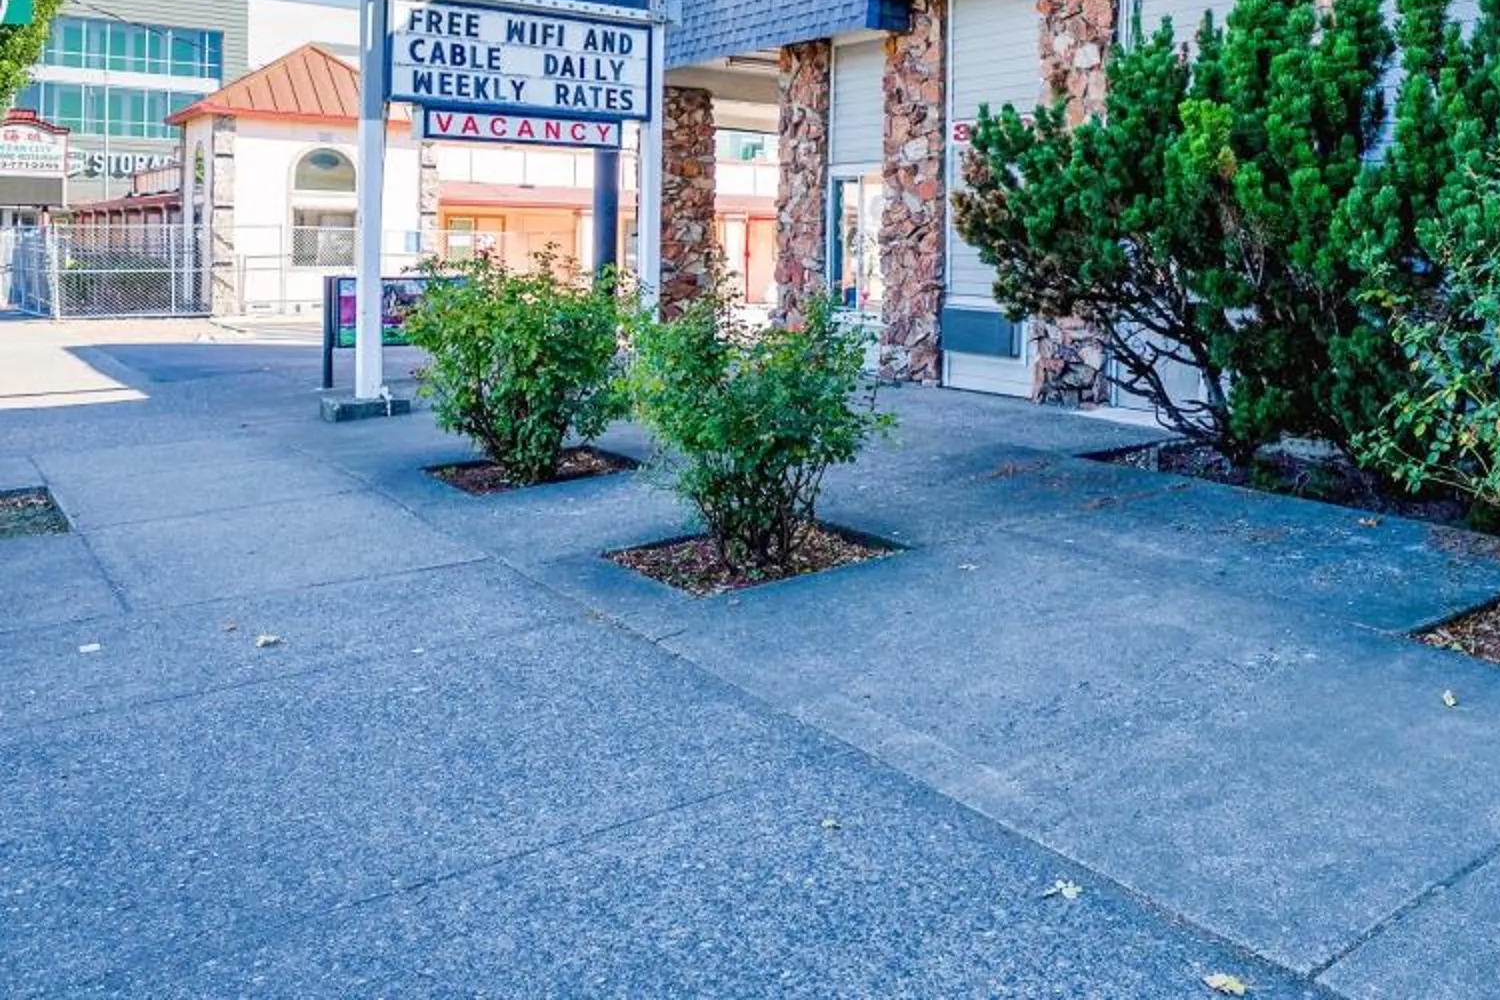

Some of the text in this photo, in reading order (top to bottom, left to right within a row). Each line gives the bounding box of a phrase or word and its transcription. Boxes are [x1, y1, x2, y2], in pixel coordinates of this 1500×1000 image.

[408, 8, 634, 55] FREE WIFI AND
[408, 38, 625, 81] CABLE DAILY
[412, 69, 634, 111] WEEKLY RATES
[435, 112, 612, 143] VACANCY
